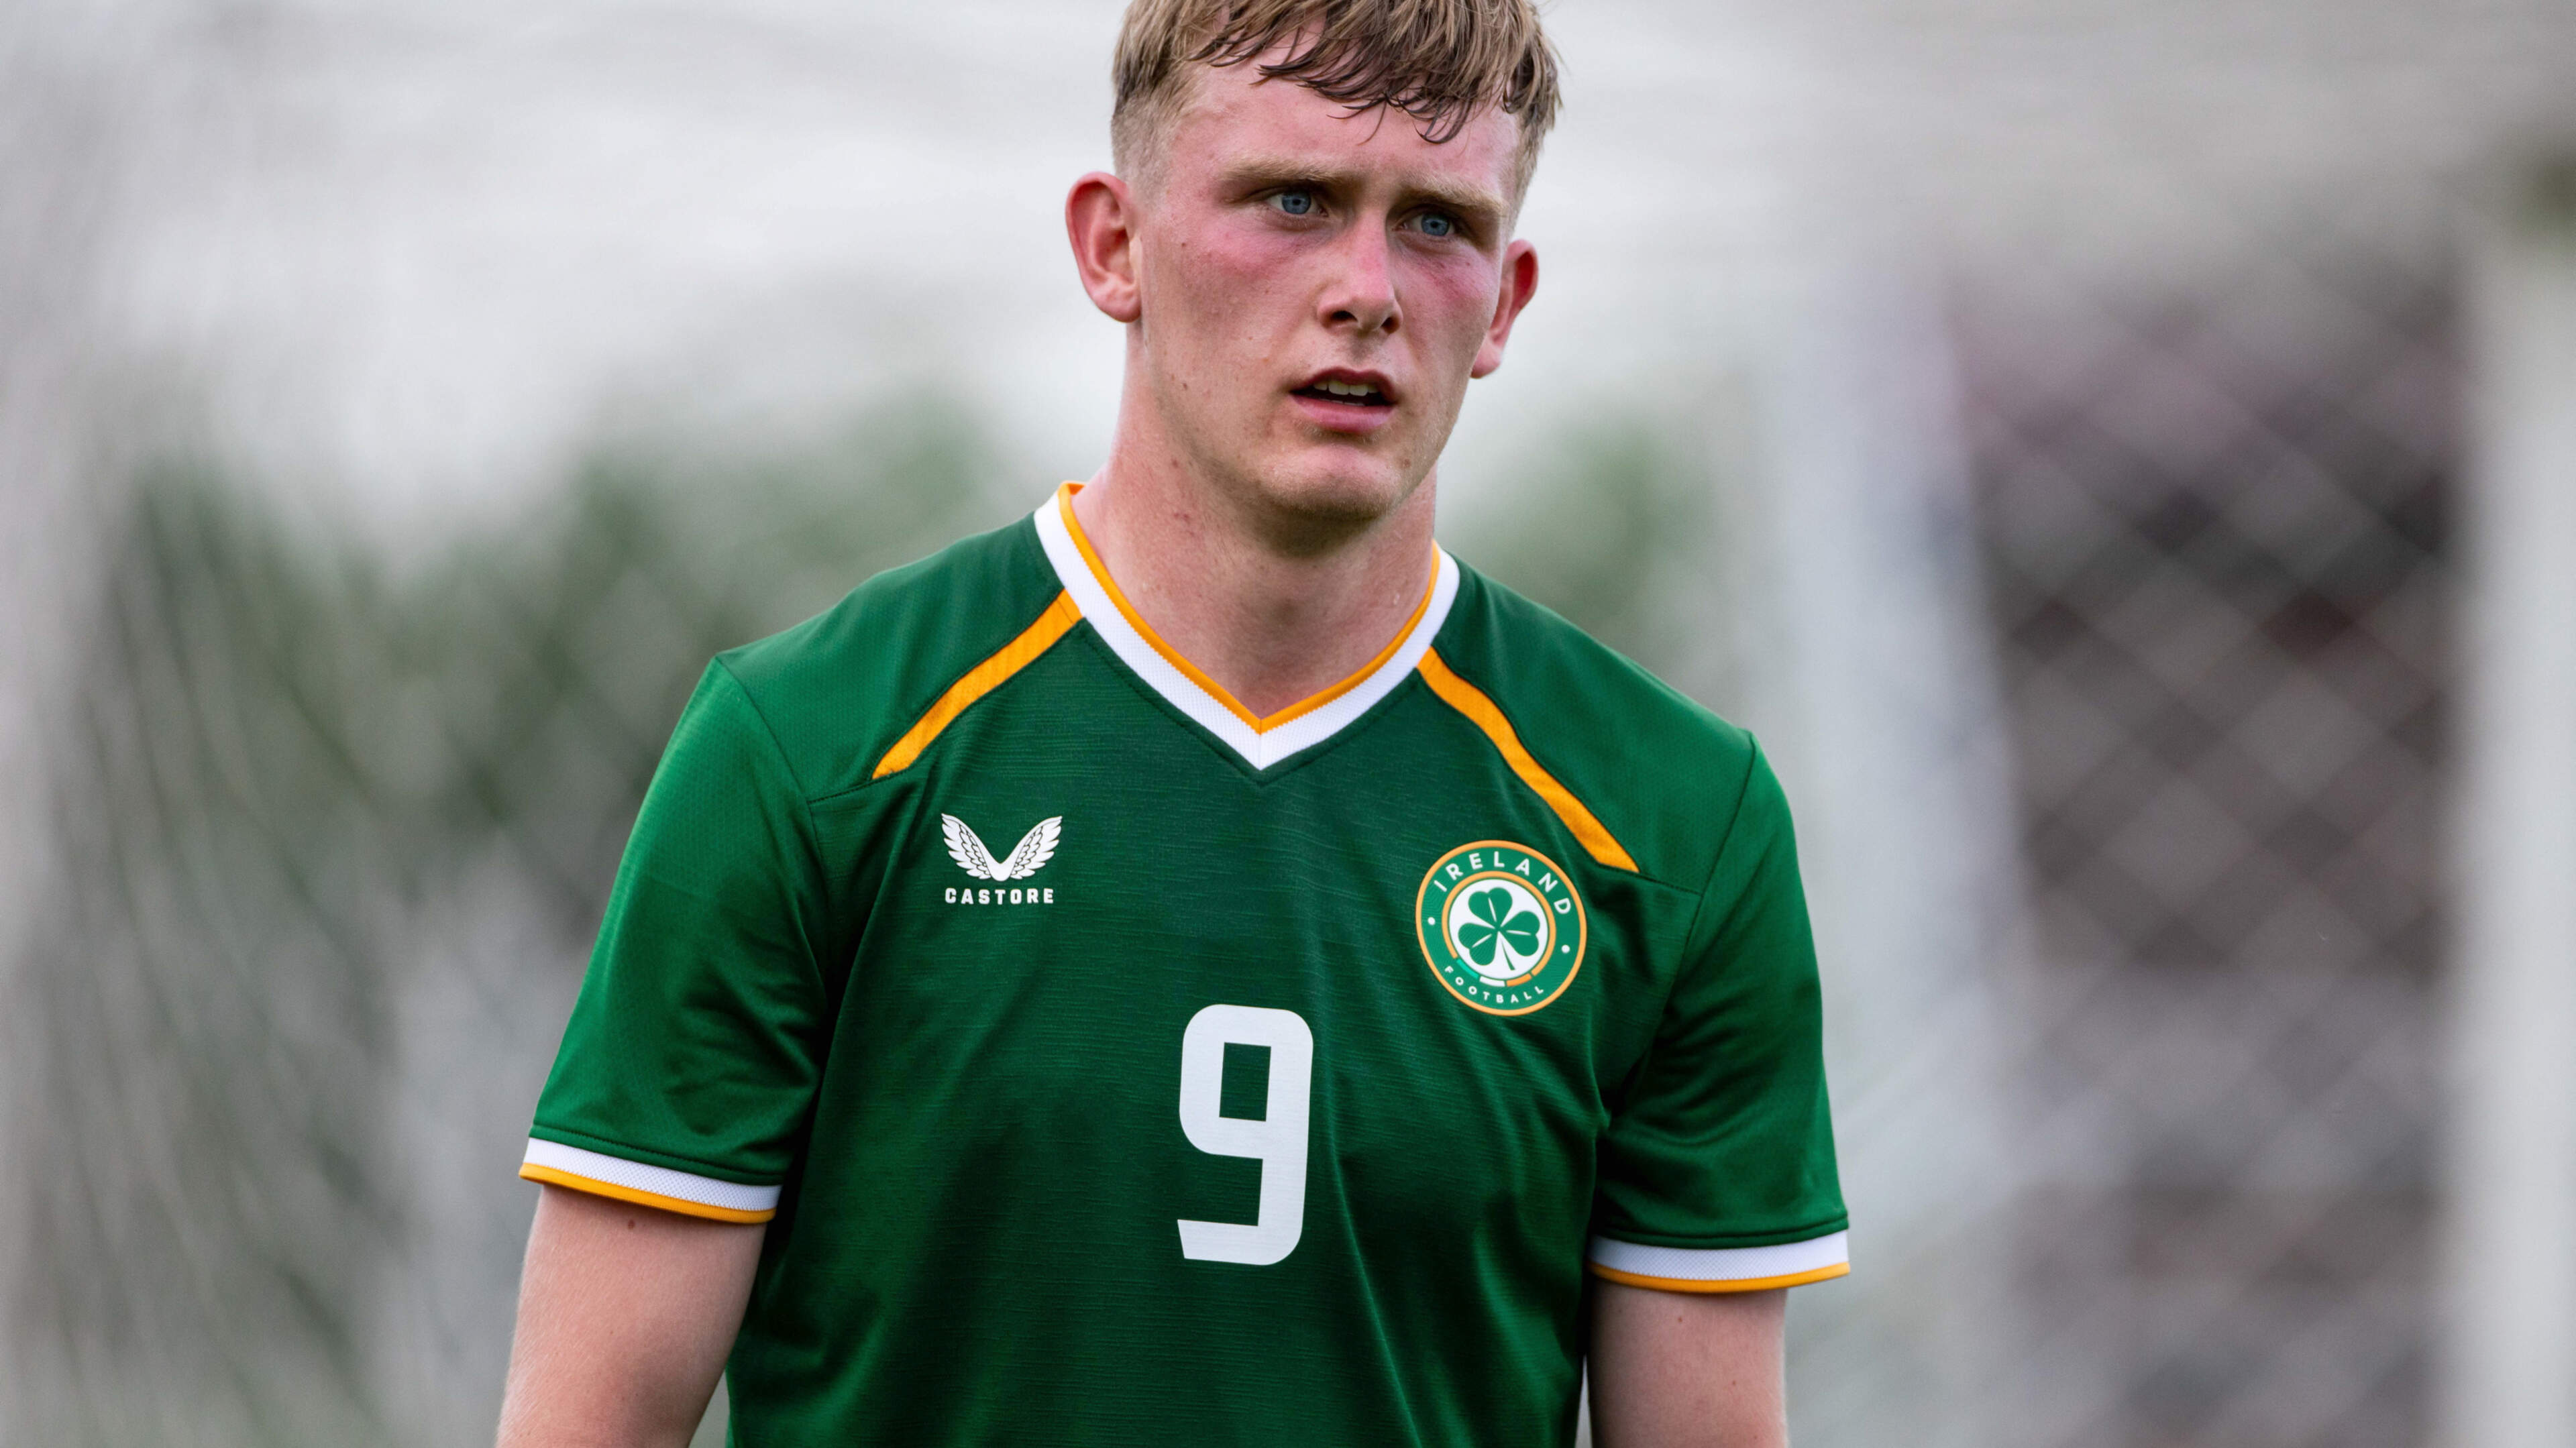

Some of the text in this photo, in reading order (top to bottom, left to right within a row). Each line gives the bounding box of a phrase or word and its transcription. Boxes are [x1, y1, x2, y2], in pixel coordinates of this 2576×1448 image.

[945, 887, 1054, 905] CASTORE
[1434, 851, 1571, 914] IRELAND
[1444, 966, 1544, 1003] FOOTBALL
[1177, 1004, 1313, 1266] 9
